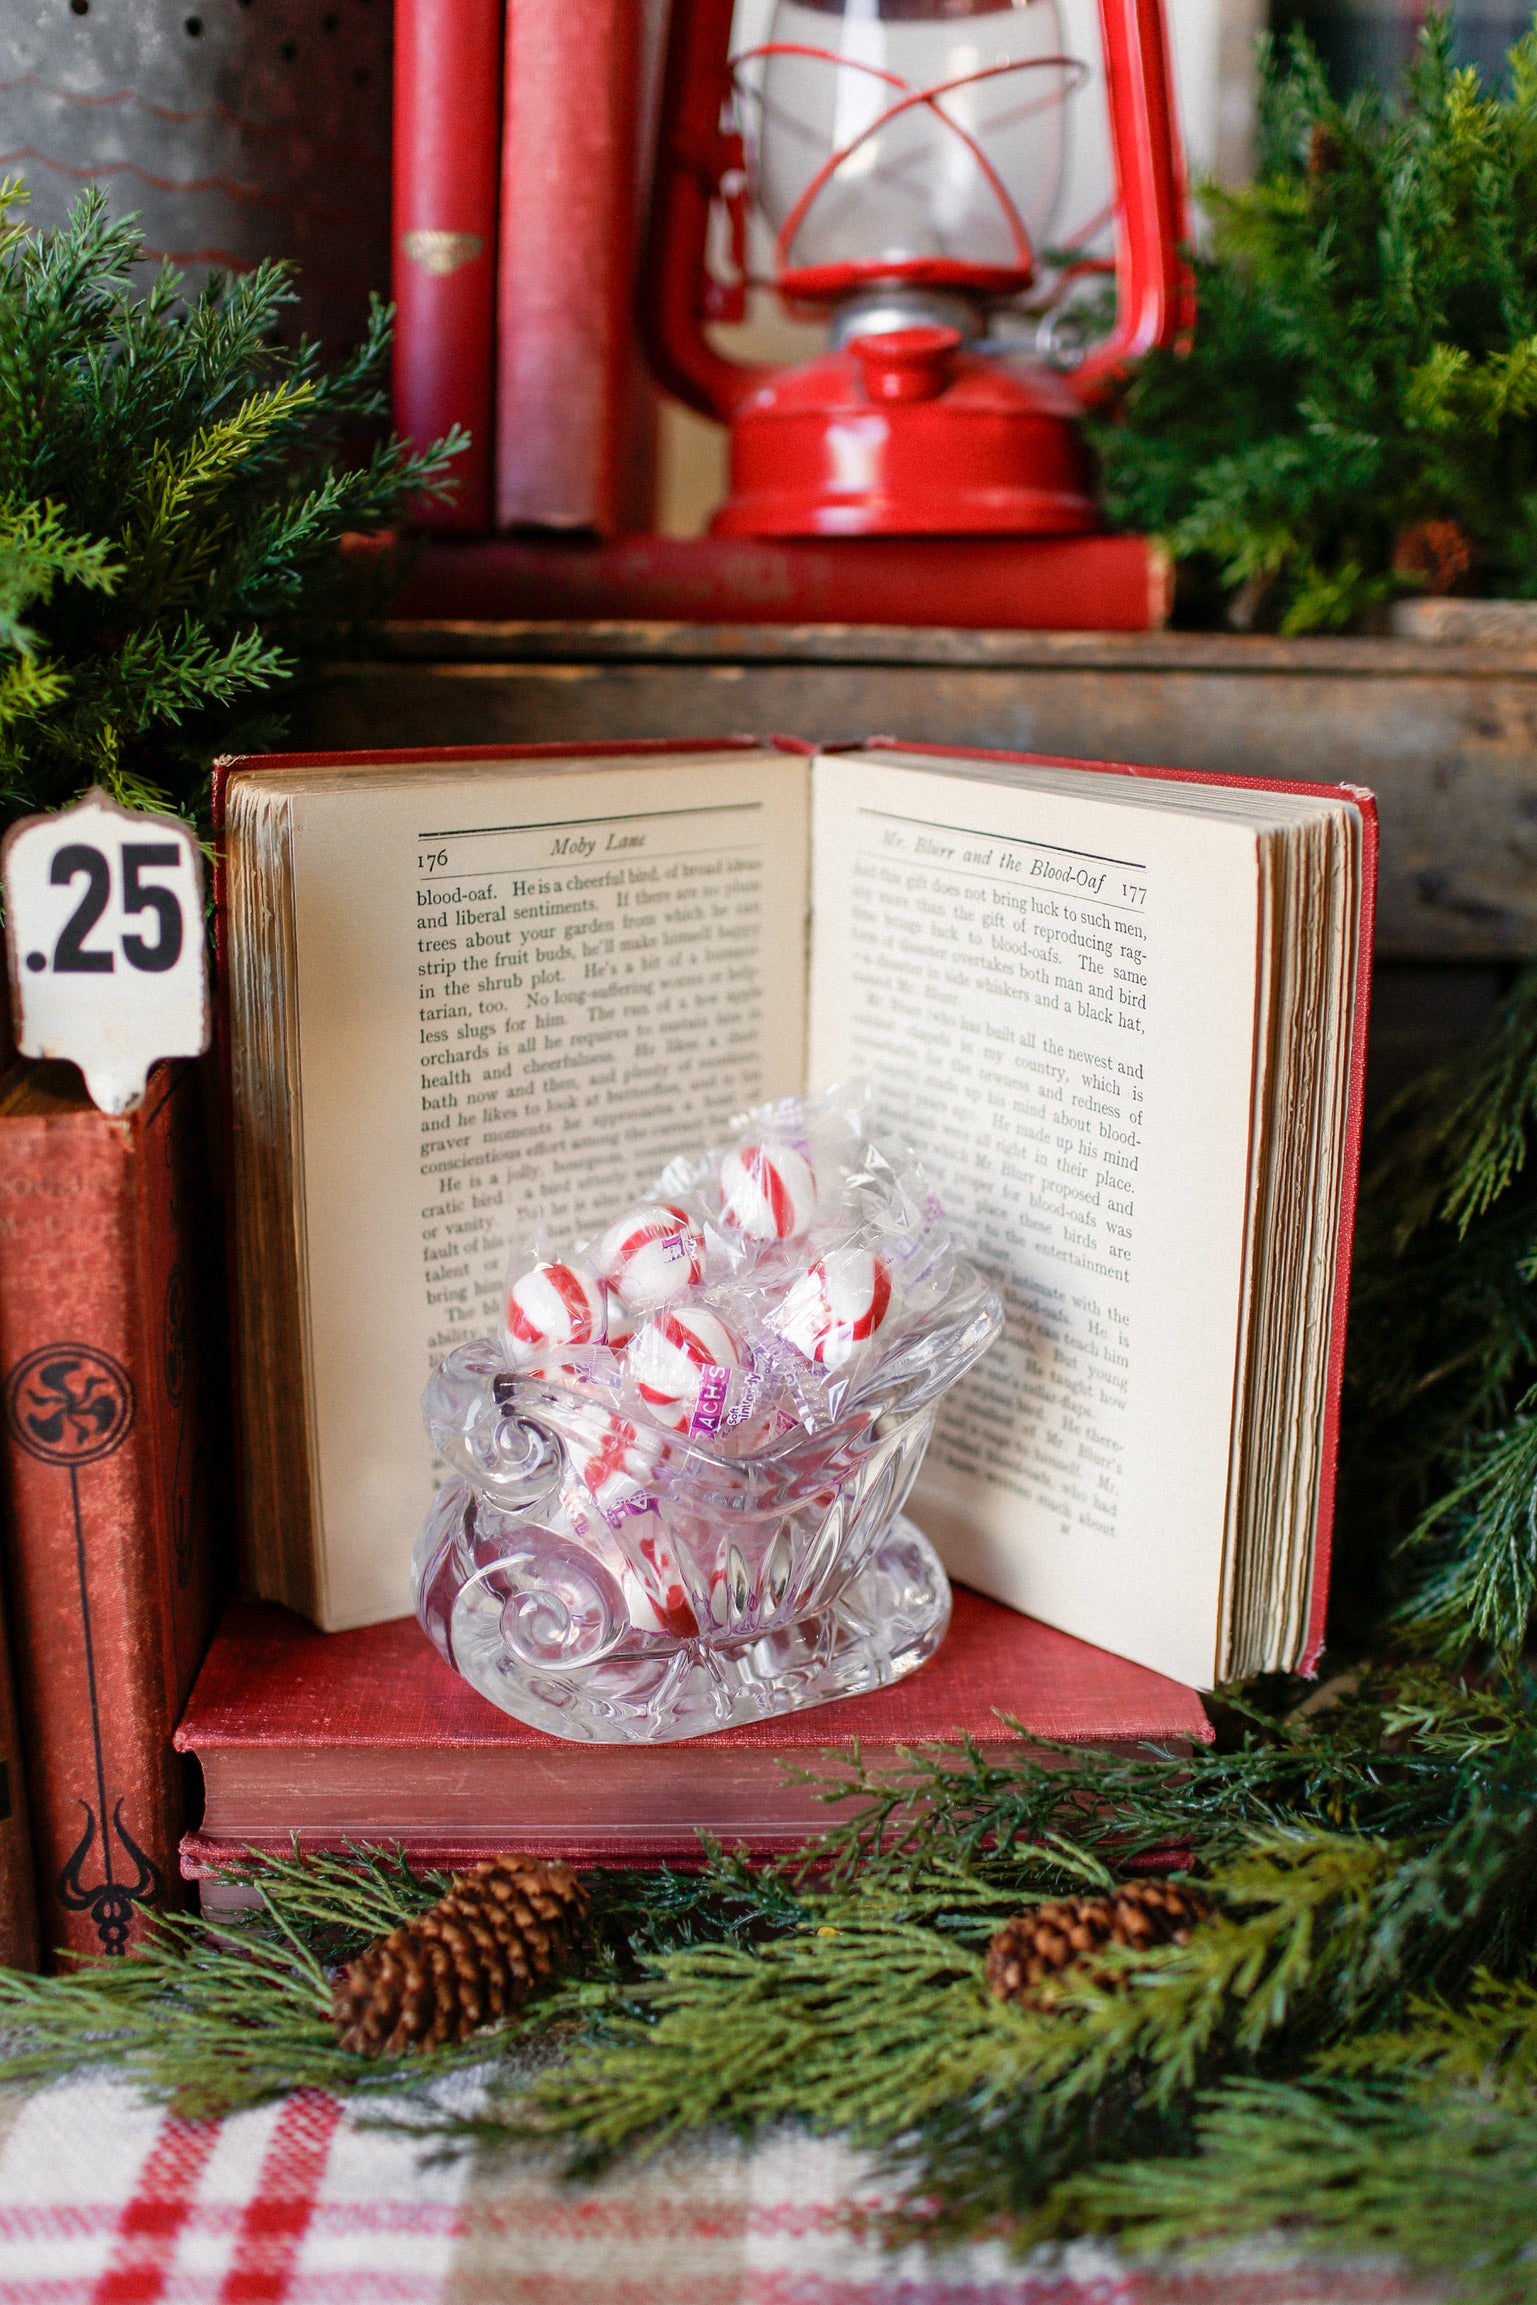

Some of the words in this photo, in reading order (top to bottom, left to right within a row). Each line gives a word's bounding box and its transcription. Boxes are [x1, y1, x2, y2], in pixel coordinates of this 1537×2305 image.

[417, 849, 448, 872] 176
[550, 836, 596, 857] Moby
[605, 833, 646, 850] Lane
[416, 883, 497, 906] blood-oaf.
[512, 880, 537, 897] He
[538, 879, 550, 895] is
[553, 882, 562, 892] a
[566, 868, 624, 890] cheerful
[962, 850, 993, 866] and
[999, 853, 1022, 872] the
[1029, 858, 1107, 894] Blood-Oaf
[1122, 883, 1147, 905] 177
[26, 843, 183, 973] .25
[416, 911, 448, 929] and
[455, 905, 505, 926] liberal
[964, 888, 986, 902] not
[992, 889, 1027, 914] bring
[1031, 896, 1059, 918] luck
[1064, 906, 1077, 922] to
[1080, 912, 1110, 930] such
[1114, 920, 1147, 941] men,
[417, 936, 457, 953] trees
[465, 929, 511, 948] about
[520, 926, 555, 945] your
[563, 917, 614, 940] garden
[982, 911, 1005, 929] gift
[1013, 918, 1026, 933] of
[1034, 924, 1113, 958] reproducing
[1120, 945, 1147, 965] rag-
[417, 959, 456, 977] strip
[463, 955, 488, 971] the
[494, 951, 529, 967] fruit
[991, 934, 1062, 964] blood-oafs.
[1078, 953, 1104, 974] The
[1113, 966, 1147, 986] same
[419, 984, 435, 999] in
[444, 980, 470, 996] the
[478, 972, 523, 993] shrub
[1020, 962, 1049, 985] both
[1055, 975, 1083, 993] man
[1088, 983, 1113, 1001] and
[1119, 987, 1147, 1010] bird
[419, 1003, 472, 1022] tarian,
[479, 1000, 508, 1014] too.
[526, 991, 549, 1009] No
[1034, 994, 1059, 1010] and
[1064, 1001, 1072, 1013] a
[1077, 1000, 1113, 1025] black
[1118, 1011, 1145, 1034] hat,
[419, 1028, 449, 1044] less
[457, 1022, 496, 1040] slugs
[505, 1017, 526, 1033] for
[420, 1044, 489, 1067] orchards
[496, 1041, 509, 1057] is
[517, 1036, 537, 1054] all
[544, 1035, 562, 1050] he
[1019, 1032, 1035, 1048] all
[1043, 1038, 1064, 1057] the
[1068, 1048, 1113, 1071] newest
[1117, 1064, 1144, 1080] and
[421, 1068, 471, 1090] health
[483, 1062, 512, 1081] and
[1014, 1054, 1070, 1084] country,
[1081, 1072, 1121, 1096] which
[1132, 1085, 1144, 1102] is
[421, 1093, 458, 1111] bath
[467, 1089, 499, 1105] now
[506, 1080, 535, 1098] and
[1038, 1084, 1063, 1102] and
[1071, 1094, 1121, 1119] redness
[1129, 1110, 1144, 1126] of
[420, 1115, 451, 1132] and
[457, 1112, 476, 1127] he
[482, 1107, 518, 1123] likes
[1052, 1110, 1092, 1133] about
[1099, 1121, 1142, 1147] blood-
[420, 1134, 471, 1157] graver
[420, 1149, 521, 1175] conscientious
[1016, 1123, 1051, 1144] made
[1056, 1136, 1073, 1154] up
[1078, 1138, 1098, 1159] his
[1103, 1150, 1139, 1172] mind
[439, 1176, 462, 1193] He
[489, 1174, 498, 1185] a
[1035, 1148, 1048, 1166] in
[1056, 1157, 1088, 1178] their
[1095, 1170, 1135, 1194] place.
[1029, 1191, 1097, 1228] blood-oafs
[1106, 1220, 1133, 1239] was
[1041, 1178, 1100, 1206] proposed
[1107, 1198, 1134, 1217] and
[423, 1241, 458, 1261] fault
[1063, 1225, 1098, 1250] birds
[1109, 1243, 1132, 1261] are
[1034, 1241, 1130, 1284] entertainment
[1071, 1295, 1101, 1317] with
[1107, 1306, 1131, 1327] the
[1088, 1318, 1108, 1339] He
[1118, 1330, 1130, 1349] is
[1104, 1346, 1129, 1369] him
[1088, 1364, 1128, 1394] young
